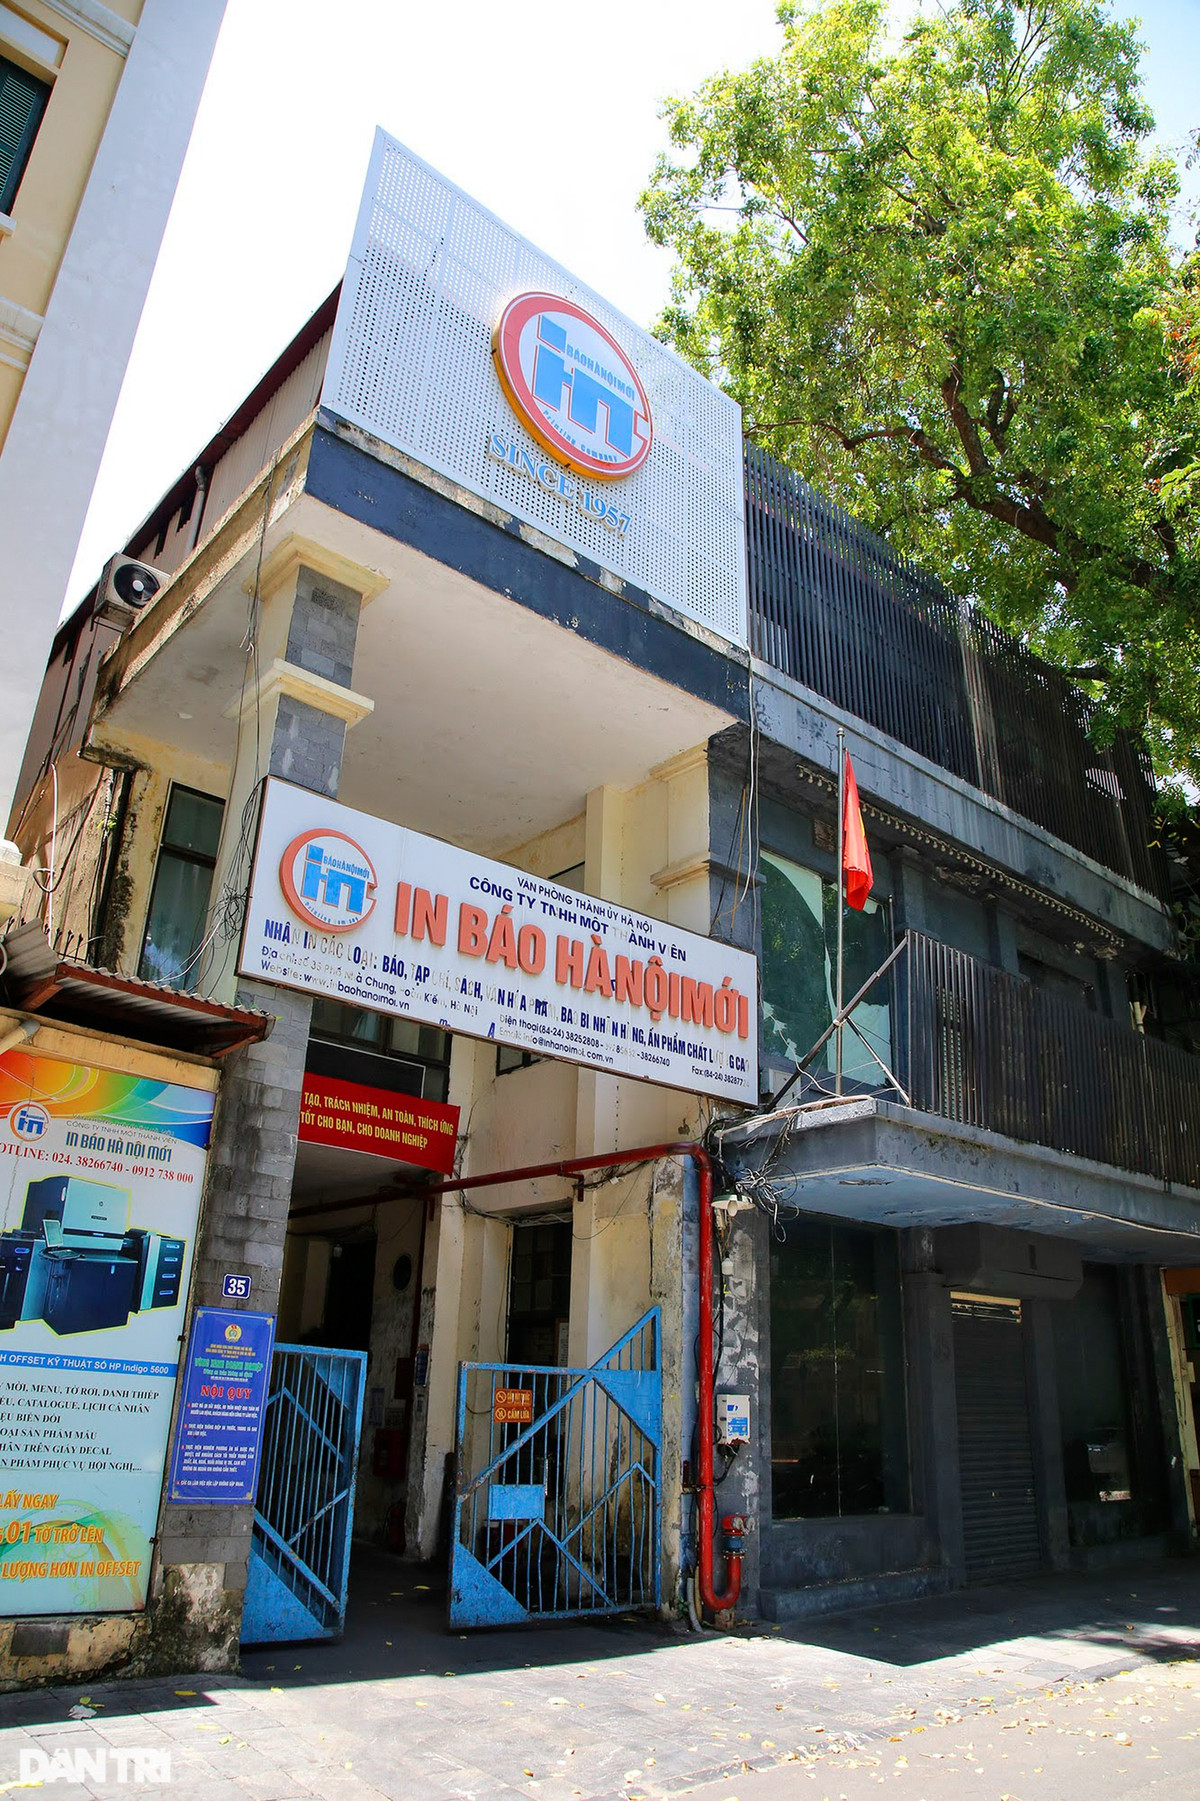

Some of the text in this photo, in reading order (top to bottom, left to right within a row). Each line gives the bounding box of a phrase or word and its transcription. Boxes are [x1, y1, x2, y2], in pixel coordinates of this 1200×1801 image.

[490, 434, 632, 535] SINCE 1957
[469, 876, 513, 902] CÔNG
[516, 892, 536, 909] TY
[540, 901, 577, 924] TNHH
[538, 886, 573, 905] PHÒNG
[575, 898, 606, 916] THÀNH
[620, 914, 634, 927] HÀ
[636, 920, 653, 933] NỘI
[394, 881, 449, 947] IN
[457, 904, 547, 975] BÁO
[303, 931, 317, 950] IN
[320, 935, 344, 959] CÁC
[382, 954, 408, 981] BÁO,
[661, 1032, 686, 1056] PHẨM
[365, 976, 397, 995] Chung,
[565, 1031, 600, 1048] 38252808
[304, 1091, 322, 1108] TẠO,
[323, 1095, 351, 1111] TRÁCH
[352, 1101, 381, 1119] NHIỆM,
[382, 1107, 393, 1120] AN
[395, 1110, 417, 1127] TOÀN,
[417, 1115, 438, 1131] THÍCH
[300, 1108, 428, 1150] TỐT CHO BẠN, CHO DOANH NGHIỆP
[80, 1132, 105, 1152] BÁO
[107, 1136, 123, 1154] HÀ
[125, 1140, 145, 1159] NỘI
[147, 1145, 172, 1162] MỚI
[52, 1152, 72, 1165] 024.
[76, 1155, 123, 1172] 38266740
[132, 1165, 155, 1178] 0912
[158, 1168, 174, 1181] 738
[176, 1172, 194, 1183] 000
[227, 1278, 246, 1295] 35
[8, 1354, 46, 1365] OFFSET
[47, 1356, 61, 1366] KỸ
[62, 1358, 92, 1370] THUẬT
[109, 1362, 121, 1371] HP
[122, 1363, 149, 1375] Indigo
[150, 1365, 169, 1374] 5600
[102, 1388, 129, 1399] DANH
[131, 1389, 160, 1400] THIẾP
[201, 1383, 252, 1401] NỘI QUY
[82, 1402, 107, 1413] LỊCH
[124, 1403, 150, 1414] NHÂN
[79, 1446, 112, 1456] DECAL
[43, 1460, 72, 1471] PHỤC
[73, 1461, 87, 1472] VỤ
[88, 1460, 108, 1472] HỘI
[22, 1493, 59, 1510] NGAY
[5, 1521, 105, 1544] 01 TỜ TRỞ LÊN
[1, 1560, 141, 1583] LƯỢNG HƠN IN OFFSET
